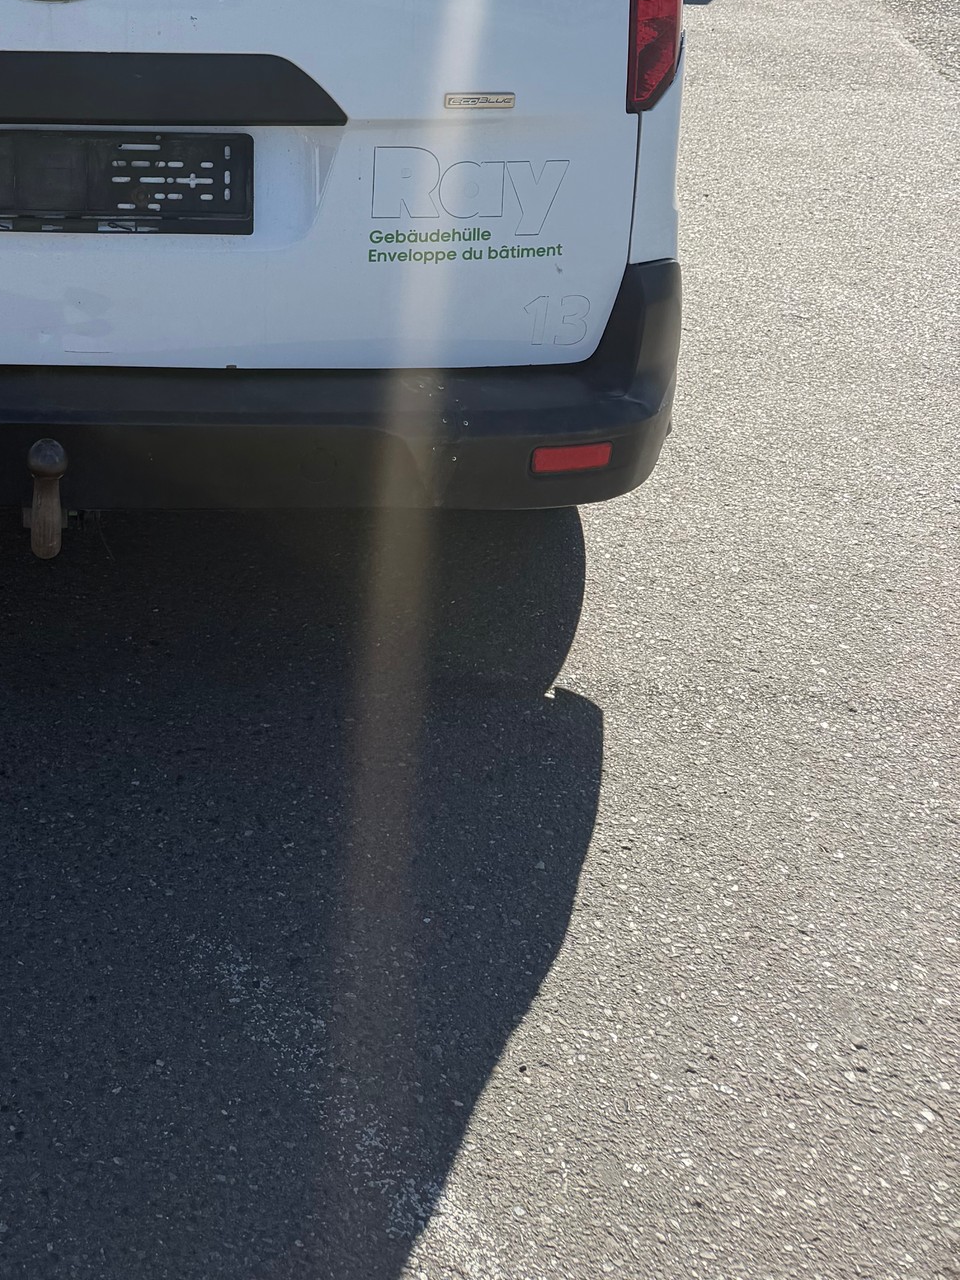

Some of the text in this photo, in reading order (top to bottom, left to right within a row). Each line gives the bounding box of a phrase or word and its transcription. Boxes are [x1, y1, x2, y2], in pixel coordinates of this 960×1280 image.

[369, 227, 492, 245] Gebäudehülle
[368, 243, 563, 265] Enveloppe du bâtiment
[523, 294, 591, 346] 13
